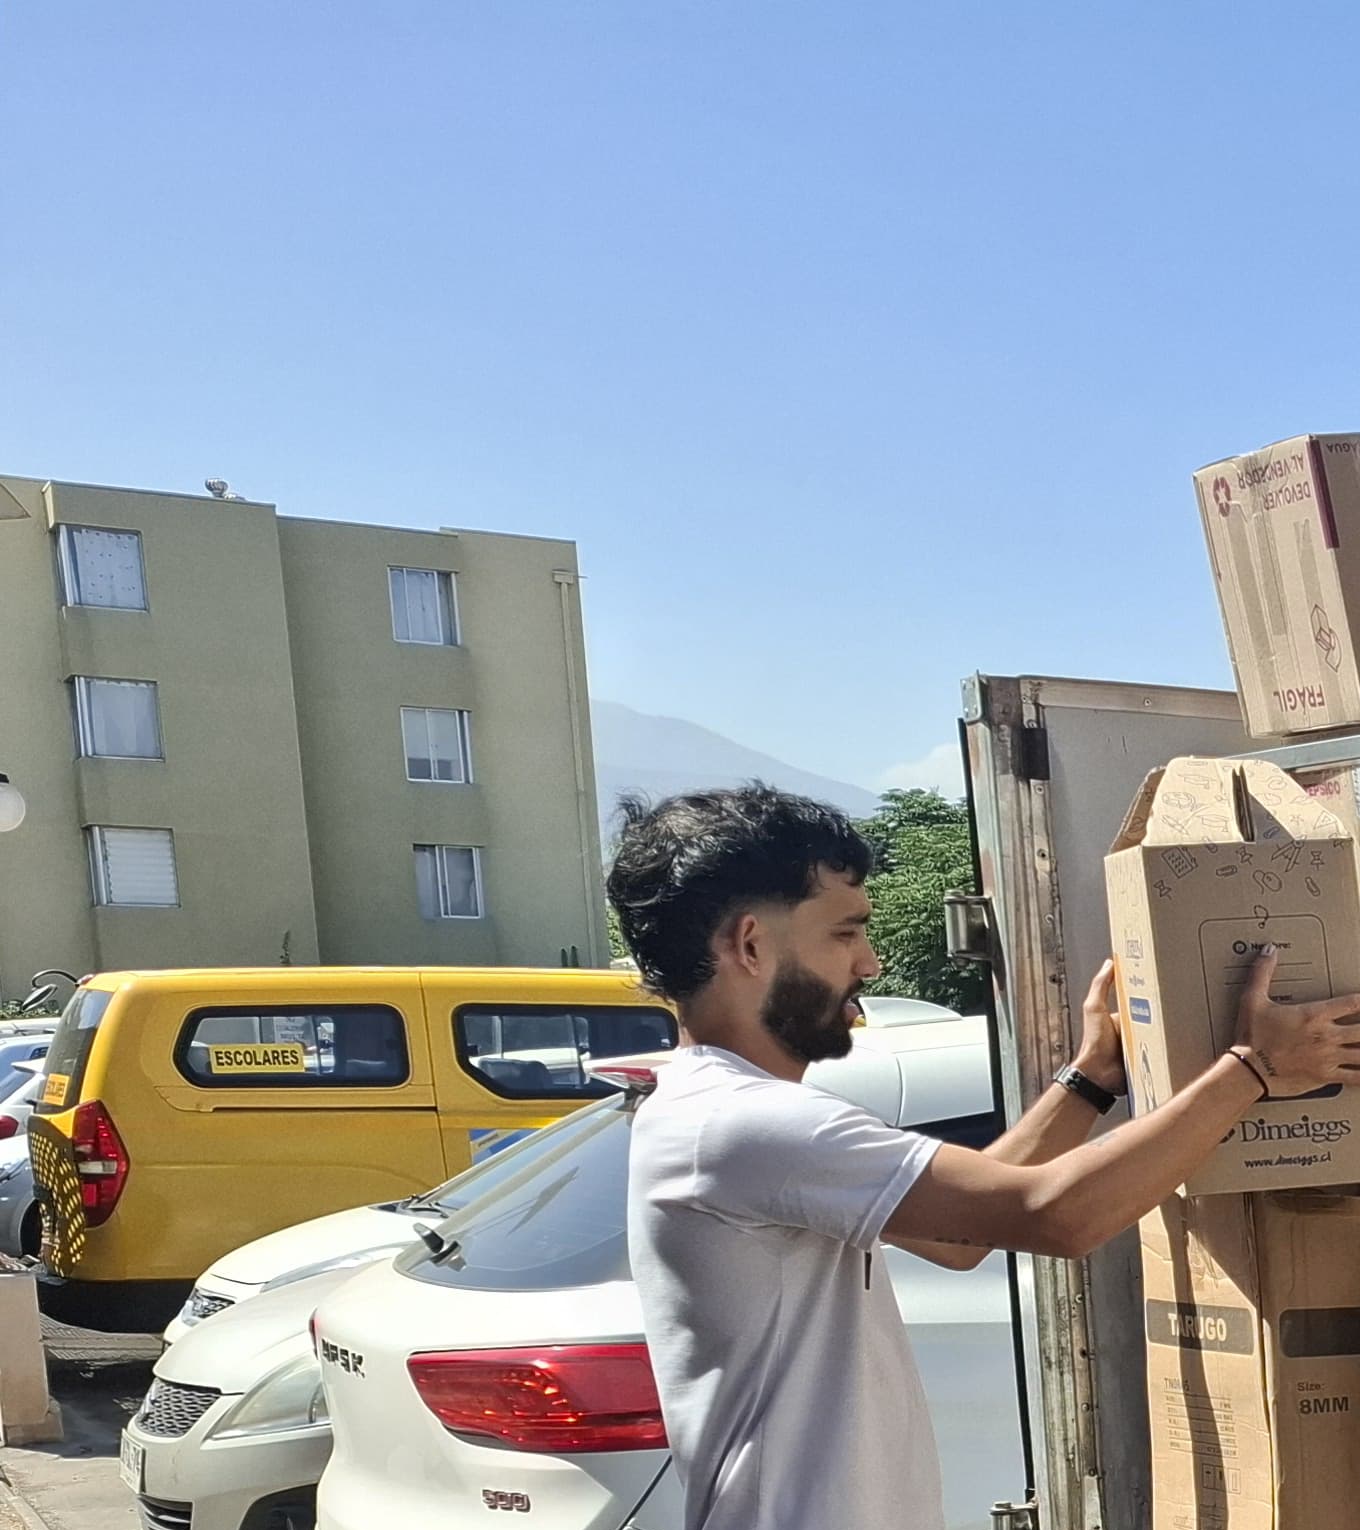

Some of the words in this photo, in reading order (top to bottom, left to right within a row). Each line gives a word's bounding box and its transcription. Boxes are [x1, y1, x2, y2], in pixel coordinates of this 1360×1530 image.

[1262, 481, 1312, 511] DEVOLVER
[1308, 781, 1341, 797] EPSICO
[214, 1050, 299, 1067] ESCOLARES
[1240, 1115, 1351, 1143] Dimeiggs
[1167, 1313, 1227, 1342] TARUGO
[1297, 1382, 1325, 1392] Size:
[1300, 1396, 1349, 1415] 8MM
